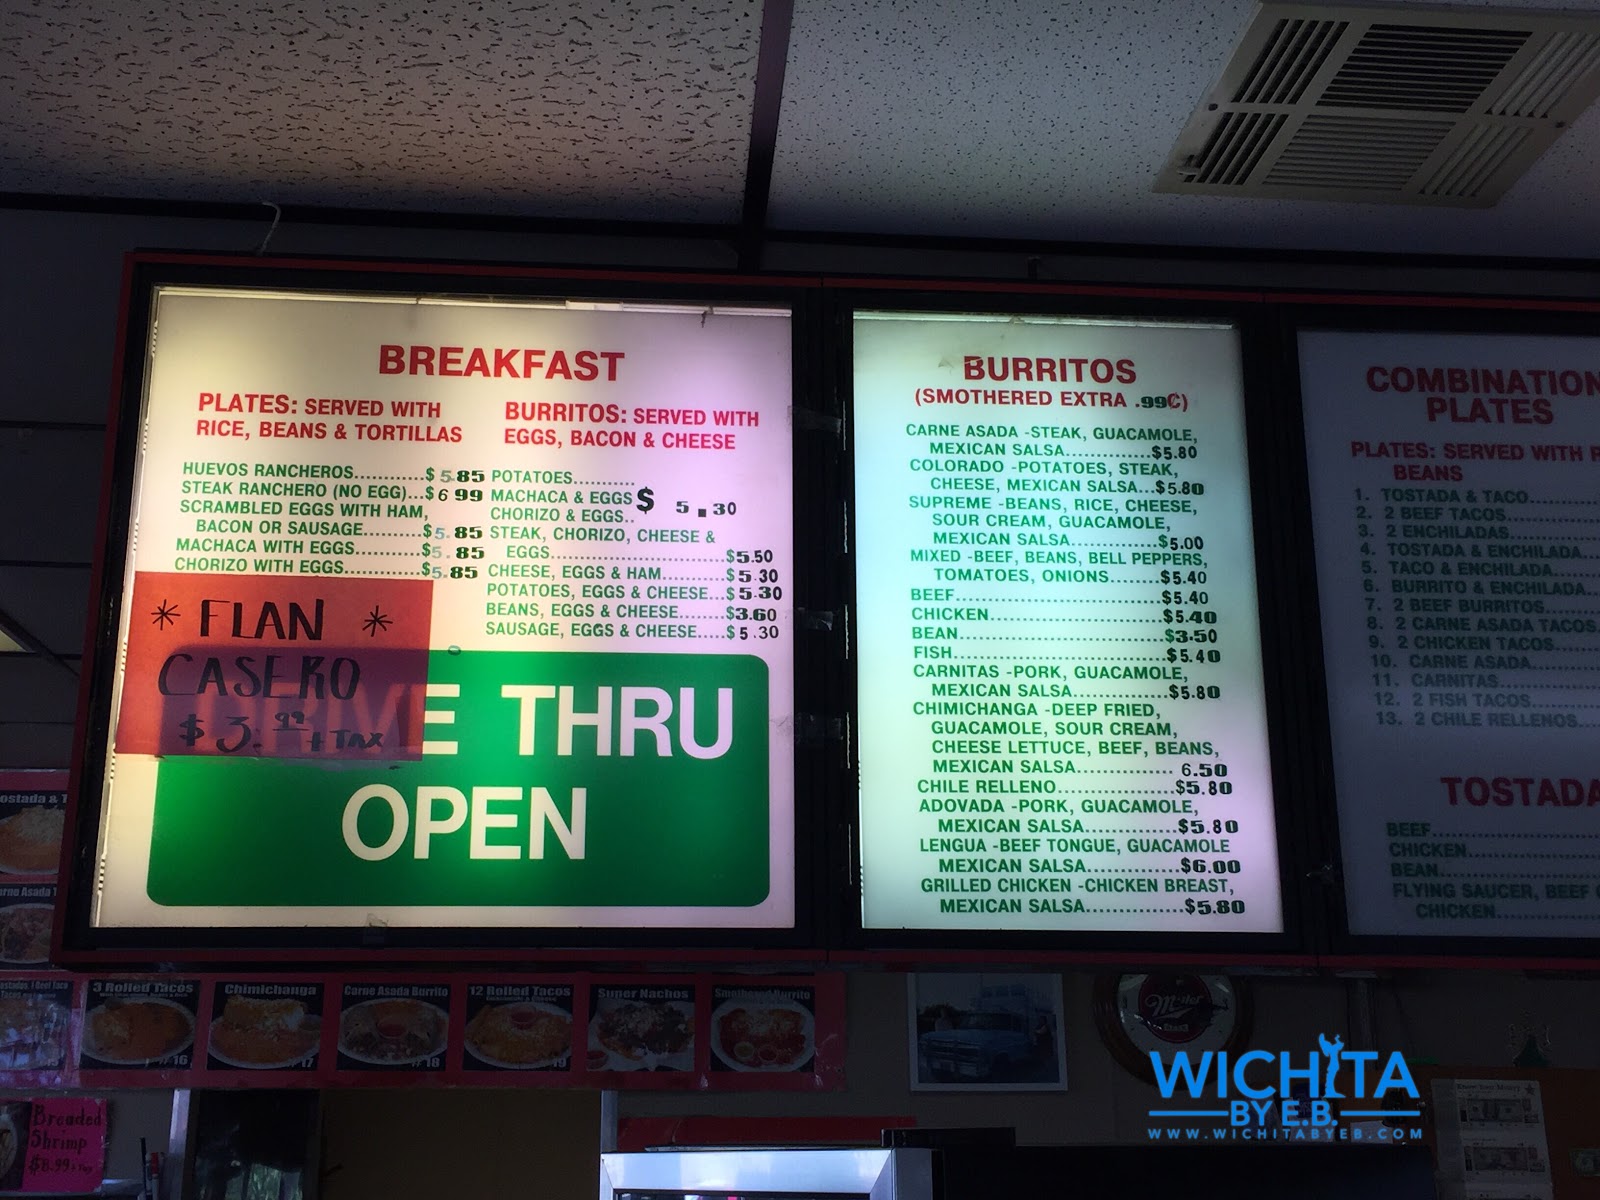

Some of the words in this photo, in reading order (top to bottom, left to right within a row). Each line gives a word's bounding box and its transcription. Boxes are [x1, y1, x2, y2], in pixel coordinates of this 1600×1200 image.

[379, 345, 625, 381] BREAKFAST
[964, 356, 1136, 384] BURRITOS
[1366, 367, 1600, 396] COMBINATION
[199, 393, 297, 414] PLATES:
[305, 398, 384, 416] SERVED
[391, 401, 441, 419] WITH
[916, 388, 1052, 406] (SMOTHERED
[1061, 391, 1127, 407] EXTRA
[506, 402, 626, 423] BURRITOS:
[633, 408, 706, 425] SERVED
[713, 411, 759, 427] WITH
[1427, 396, 1554, 425] PLATES
[197, 420, 250, 440] RICE,
[259, 421, 327, 439] BEANS
[334, 423, 347, 439] &
[355, 424, 462, 443] TORTILLAS
[505, 428, 562, 449] EGGS,
[571, 430, 636, 447] BACON
[643, 432, 655, 448] &
[662, 432, 735, 449] CHEESE
[906, 424, 960, 436] CARNE
[966, 425, 1018, 437] ASADA
[1093, 427, 1197, 444] GUACAMOLE,
[930, 442, 1005, 455] MEXICAN
[1013, 444, 1065, 456] SALSA
[1152, 445, 1197, 460] $5.80
[1351, 440, 1437, 459] PLATES:
[1443, 443, 1524, 460] SERVED
[1530, 445, 1583, 462] WITH
[183, 462, 248, 476] HUEVOS
[255, 464, 353, 479] RANCHEROS
[492, 470, 572, 484] POTATOES
[910, 459, 1004, 473] COLORADO
[1119, 462, 1178, 479] STEAK,
[1393, 464, 1463, 482] BEANS
[182, 481, 233, 494] STEAK
[239, 482, 327, 497] RANCHERO
[333, 484, 362, 500] (NO
[368, 485, 406, 502] EGG)
[1380, 488, 1461, 503] TOSTADA
[1482, 489, 1530, 504] TACO
[180, 500, 282, 515] SCRAMBLED
[289, 502, 334, 516] EGGS
[340, 503, 381, 517] WITH
[387, 504, 428, 521] HAM,
[909, 496, 991, 509] SUPREME
[1074, 499, 1118, 514] RICE,
[1125, 499, 1197, 516] CHEESE,
[1399, 506, 1444, 521] BEEF
[1448, 507, 1507, 523] TACOS
[196, 519, 252, 533] BACON
[259, 520, 282, 534] OR
[288, 521, 364, 536] SAUSAGE
[932, 513, 979, 526] SOUR
[986, 514, 1051, 530] CREAM,
[1059, 515, 1170, 532] GUACAMOLE,
[490, 526, 546, 542] STEAK,
[554, 527, 630, 544] CHORIZO,
[638, 529, 699, 542] CHEESE
[706, 531, 715, 543] &
[1401, 524, 1510, 540] ENCHILADAS
[176, 538, 257, 552] MACHACA
[263, 540, 304, 553] WITH
[310, 541, 354, 555] EGGS
[507, 545, 549, 559] EGGS
[727, 549, 773, 563] $5.50
[911, 549, 961, 562] MIXED
[1025, 551, 1082, 567] BEANS,
[1089, 552, 1126, 564] BELL
[1132, 552, 1207, 569] PEPPERS,
[934, 568, 1035, 584] TOMATOES,
[1042, 569, 1109, 583] ONIONS
[1160, 569, 1207, 585] $5.40
[1391, 578, 1467, 594] BURRITO
[1490, 581, 1586, 596] ENCHILADA
[911, 588, 954, 601] BEEF
[1162, 590, 1208, 606] $5.40
[198, 598, 324, 642] FLAN
[487, 603, 543, 619] BEANS,
[552, 604, 594, 617] EGGS
[601, 604, 610, 617] &
[617, 604, 678, 618] CHEESE
[912, 607, 988, 620] CHICKEN
[912, 627, 958, 639] BEAN
[1412, 616, 1471, 632] CARNE
[1476, 618, 1534, 633] ASADA
[1537, 618, 1600, 634] TACOS
[1414, 635, 1492, 651] CHICKEN
[1496, 637, 1554, 651] TACOS
[914, 646, 952, 659] FISH
[158, 653, 360, 700] CASERO
[1411, 672, 1499, 689] CARNITAS
[1429, 693, 1467, 707] FISH
[1472, 693, 1531, 708] TACOS
[913, 702, 1038, 716] CHIMICHANGA
[1104, 703, 1160, 720] FRIED,
[1431, 712, 1482, 727] CHILE
[501, 684, 733, 759] THRU
[932, 740, 1002, 754] CHEESE
[1008, 741, 1091, 757] LETTUCE,
[1099, 741, 1148, 758] BEEF,
[1155, 741, 1219, 758] BEANS,
[917, 779, 969, 793] CHILE
[976, 780, 1056, 793] RELLENO
[342, 784, 587, 861] OPEN
[1384, 820, 1431, 838] BEEF
[920, 838, 987, 852] LENGUA
[1046, 838, 1121, 855] TONGUE,
[1127, 838, 1230, 853] GUACAMOLE
[1389, 843, 1467, 857] CHICKEN
[1391, 863, 1438, 877] BEAN
[1392, 881, 1456, 899] FLYING
[1460, 882, 1539, 902] SAUCER,
[1545, 883, 1590, 900] BEEF
[92, 983, 102, 993] 3
[105, 983, 151, 993] Rolled
[153, 983, 194, 993] Tacos
[225, 983, 317, 996] Chimichanga
[345, 985, 375, 996] Carne
[378, 985, 409, 996] Asada
[469, 985, 483, 996] 12
[486, 985, 530, 997] Rolled
[531, 986, 570, 997] Tacos
[640, 988, 689, 999] Nachos
[33, 1104, 101, 1127] Breaded
[31, 1130, 87, 1154] Shrimp
